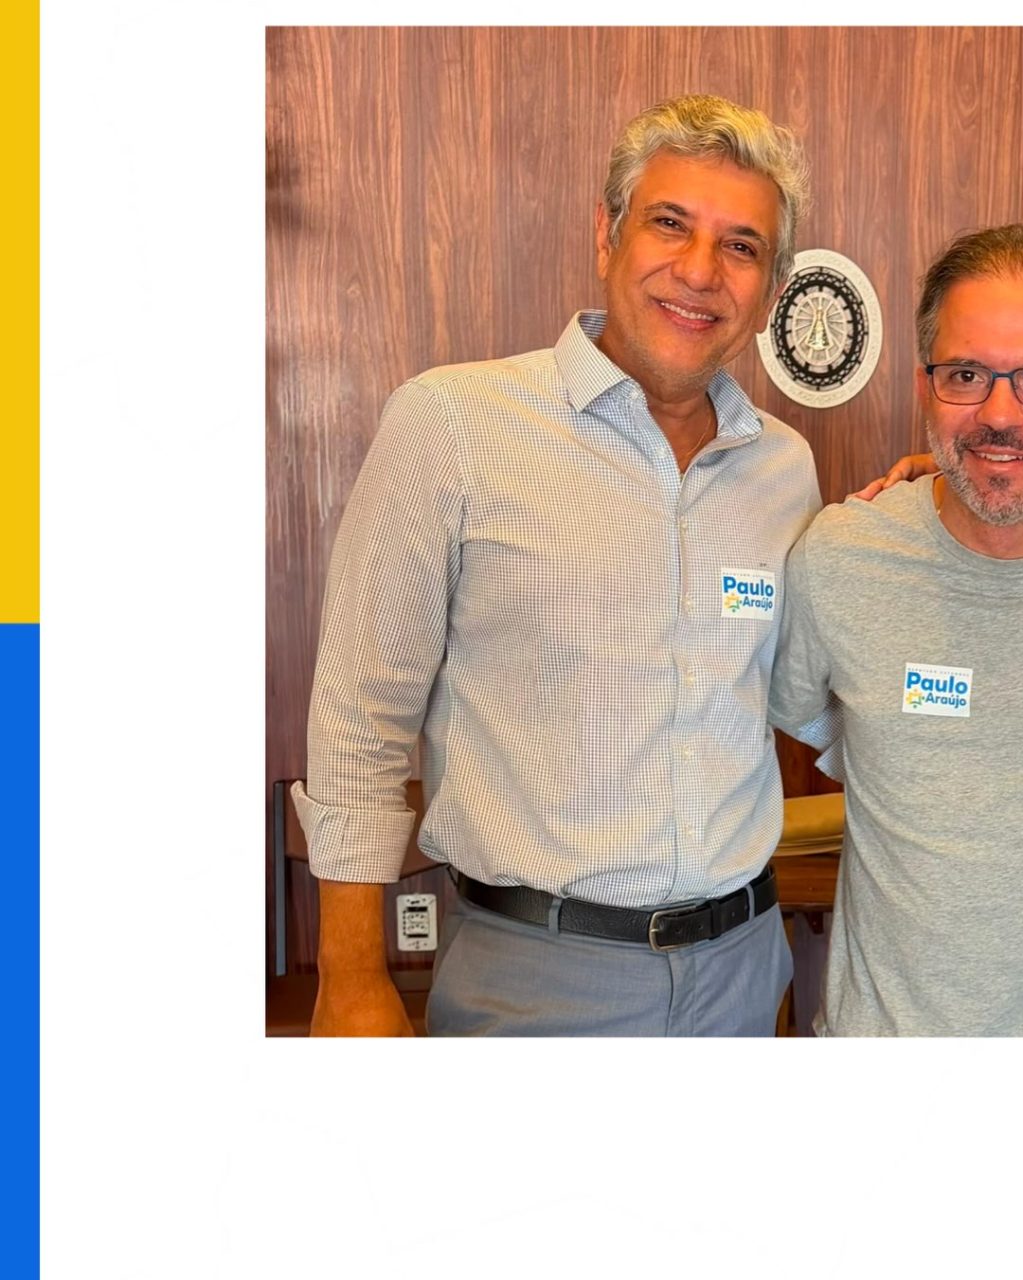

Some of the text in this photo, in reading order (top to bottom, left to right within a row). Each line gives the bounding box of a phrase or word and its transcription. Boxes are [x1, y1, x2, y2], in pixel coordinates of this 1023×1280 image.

[723, 576, 774, 597] Paulo
[742, 596, 773, 612] Araújo
[906, 671, 968, 695] Paulo
[924, 692, 967, 709] Araújo
